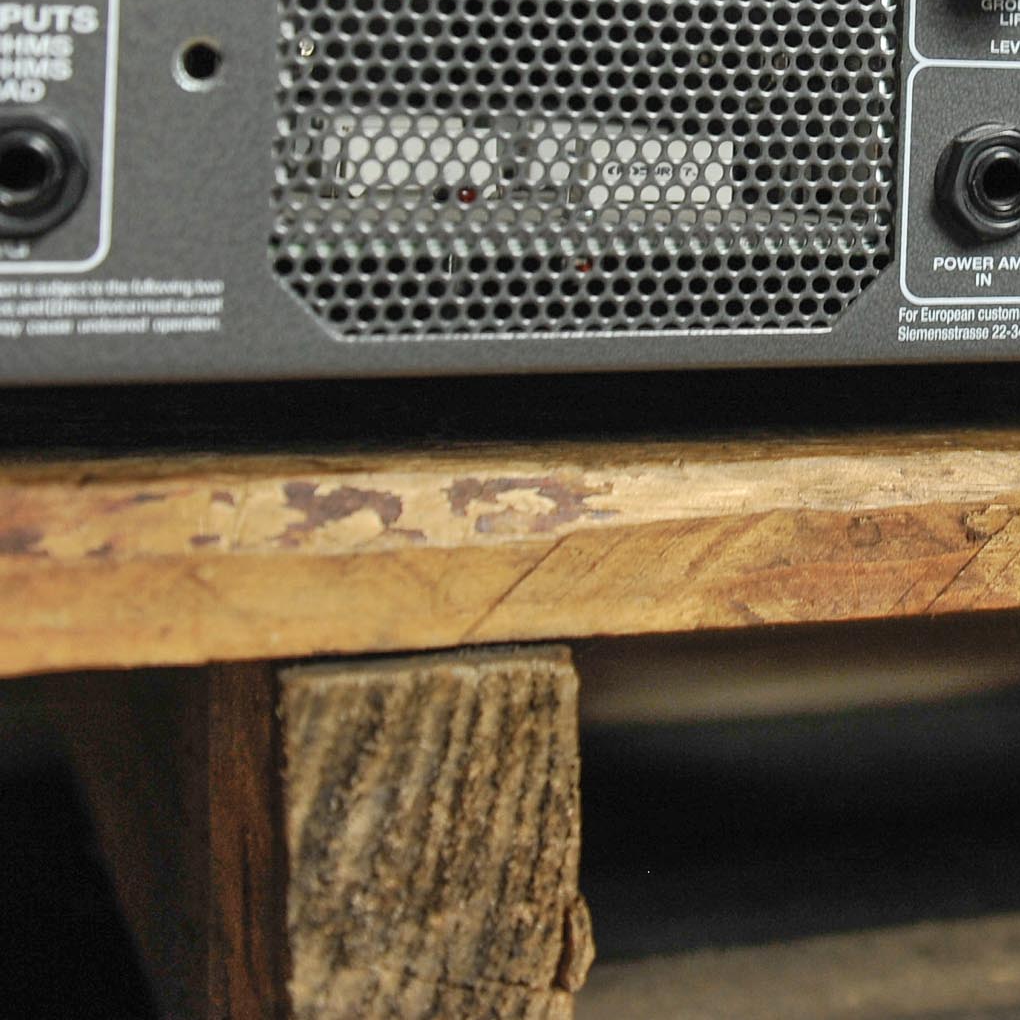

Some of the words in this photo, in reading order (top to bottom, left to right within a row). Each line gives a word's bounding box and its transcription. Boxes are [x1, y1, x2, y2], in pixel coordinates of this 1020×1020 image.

[933, 256, 994, 271] POWER
[975, 272, 992, 287] IN
[898, 306, 918, 323] For
[921, 306, 975, 325] European
[898, 325, 989, 341] Siemensstrasse
